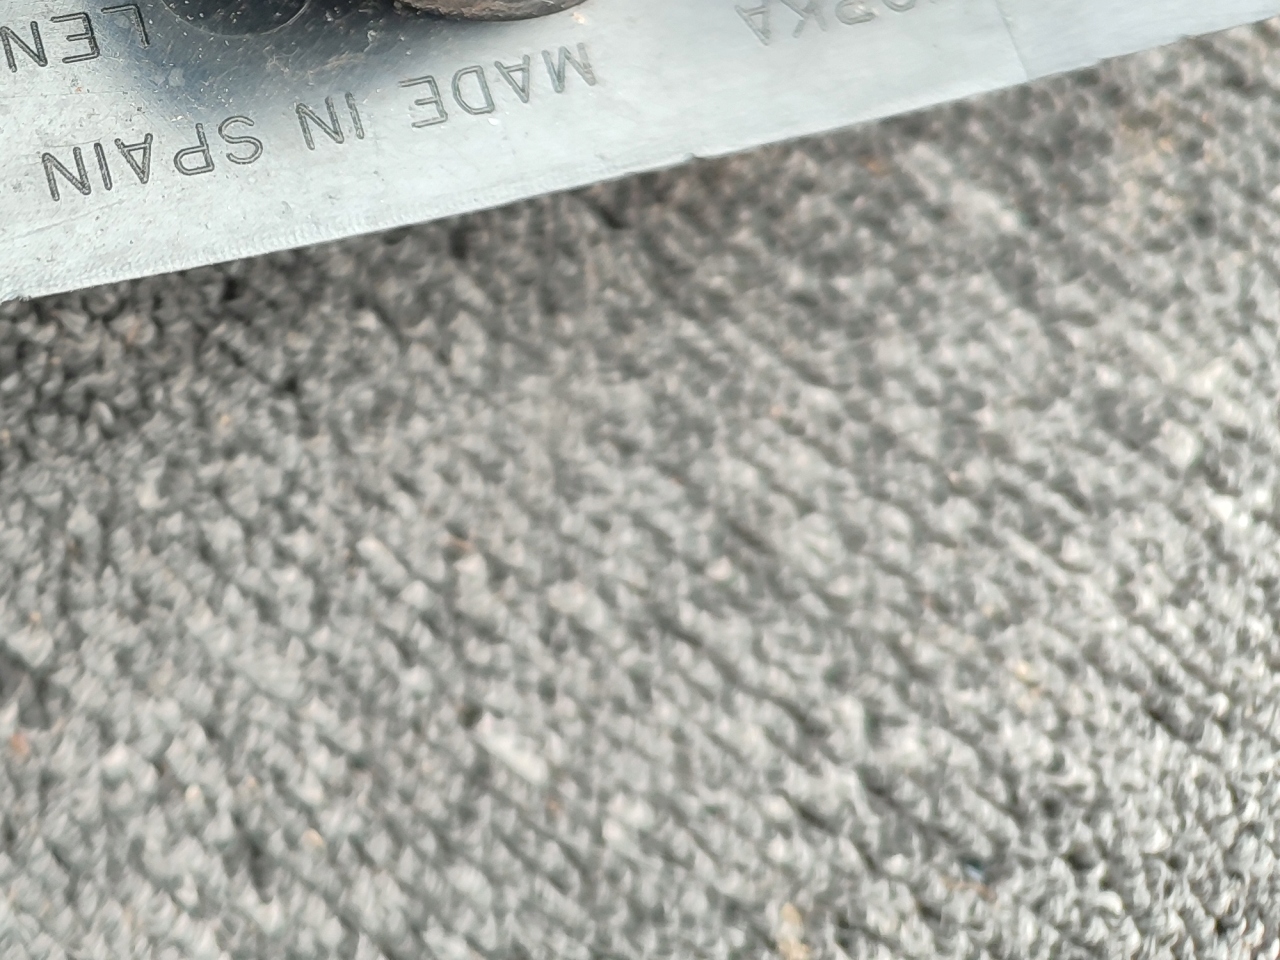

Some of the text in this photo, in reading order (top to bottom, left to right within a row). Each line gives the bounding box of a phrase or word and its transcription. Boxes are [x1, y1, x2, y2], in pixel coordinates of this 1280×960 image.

[42, 42, 596, 202] MADE IN SPAIN
